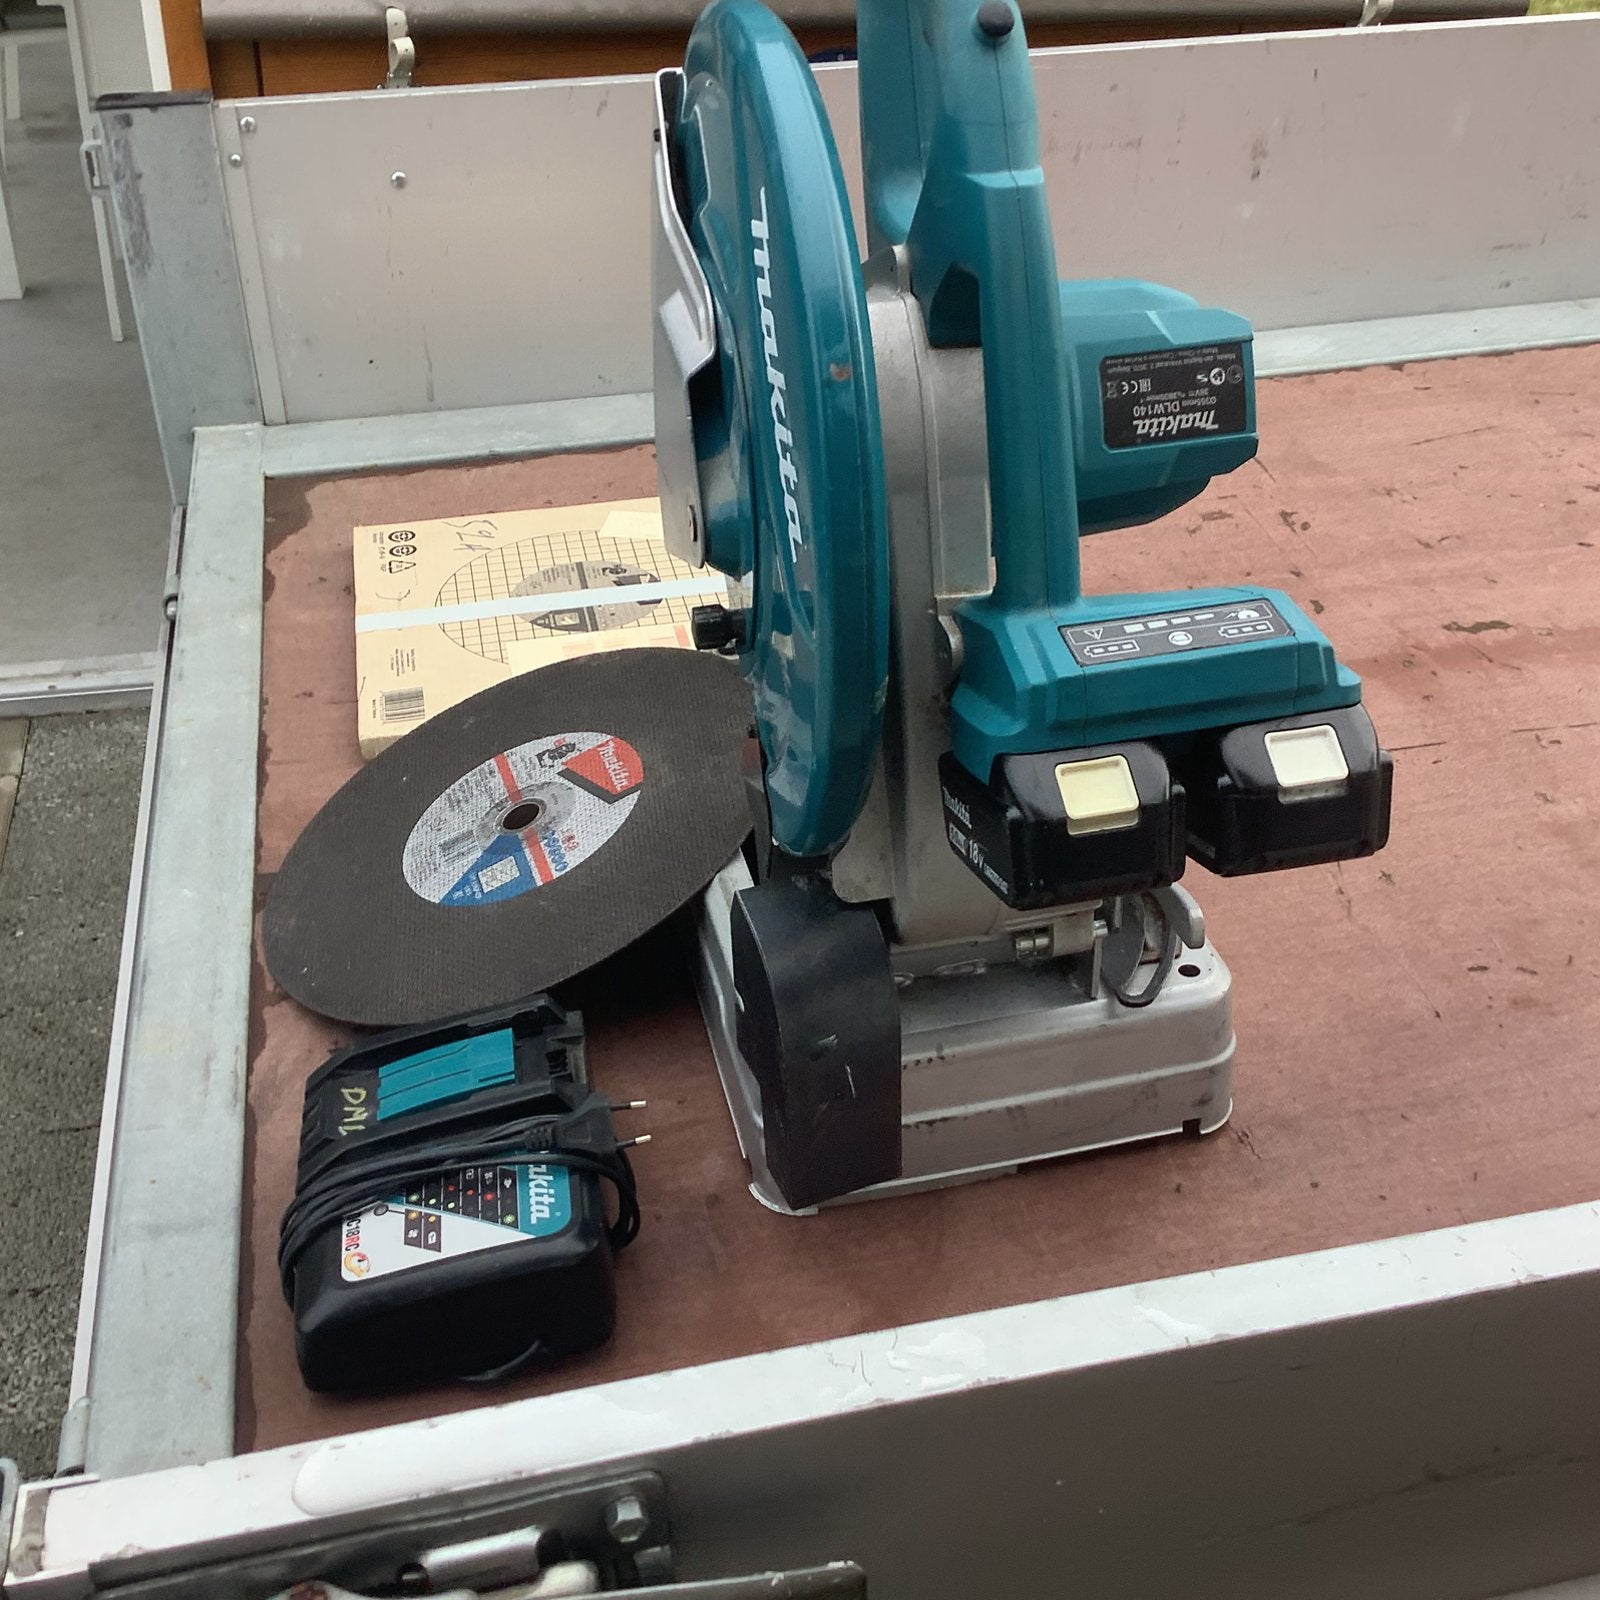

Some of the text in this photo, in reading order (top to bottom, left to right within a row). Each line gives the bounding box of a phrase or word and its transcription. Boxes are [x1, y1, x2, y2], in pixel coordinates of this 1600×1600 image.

[1133, 400, 1180, 417] DLW140
[338, 1087, 368, 1137] DML
[527, 1150, 554, 1225] akita
